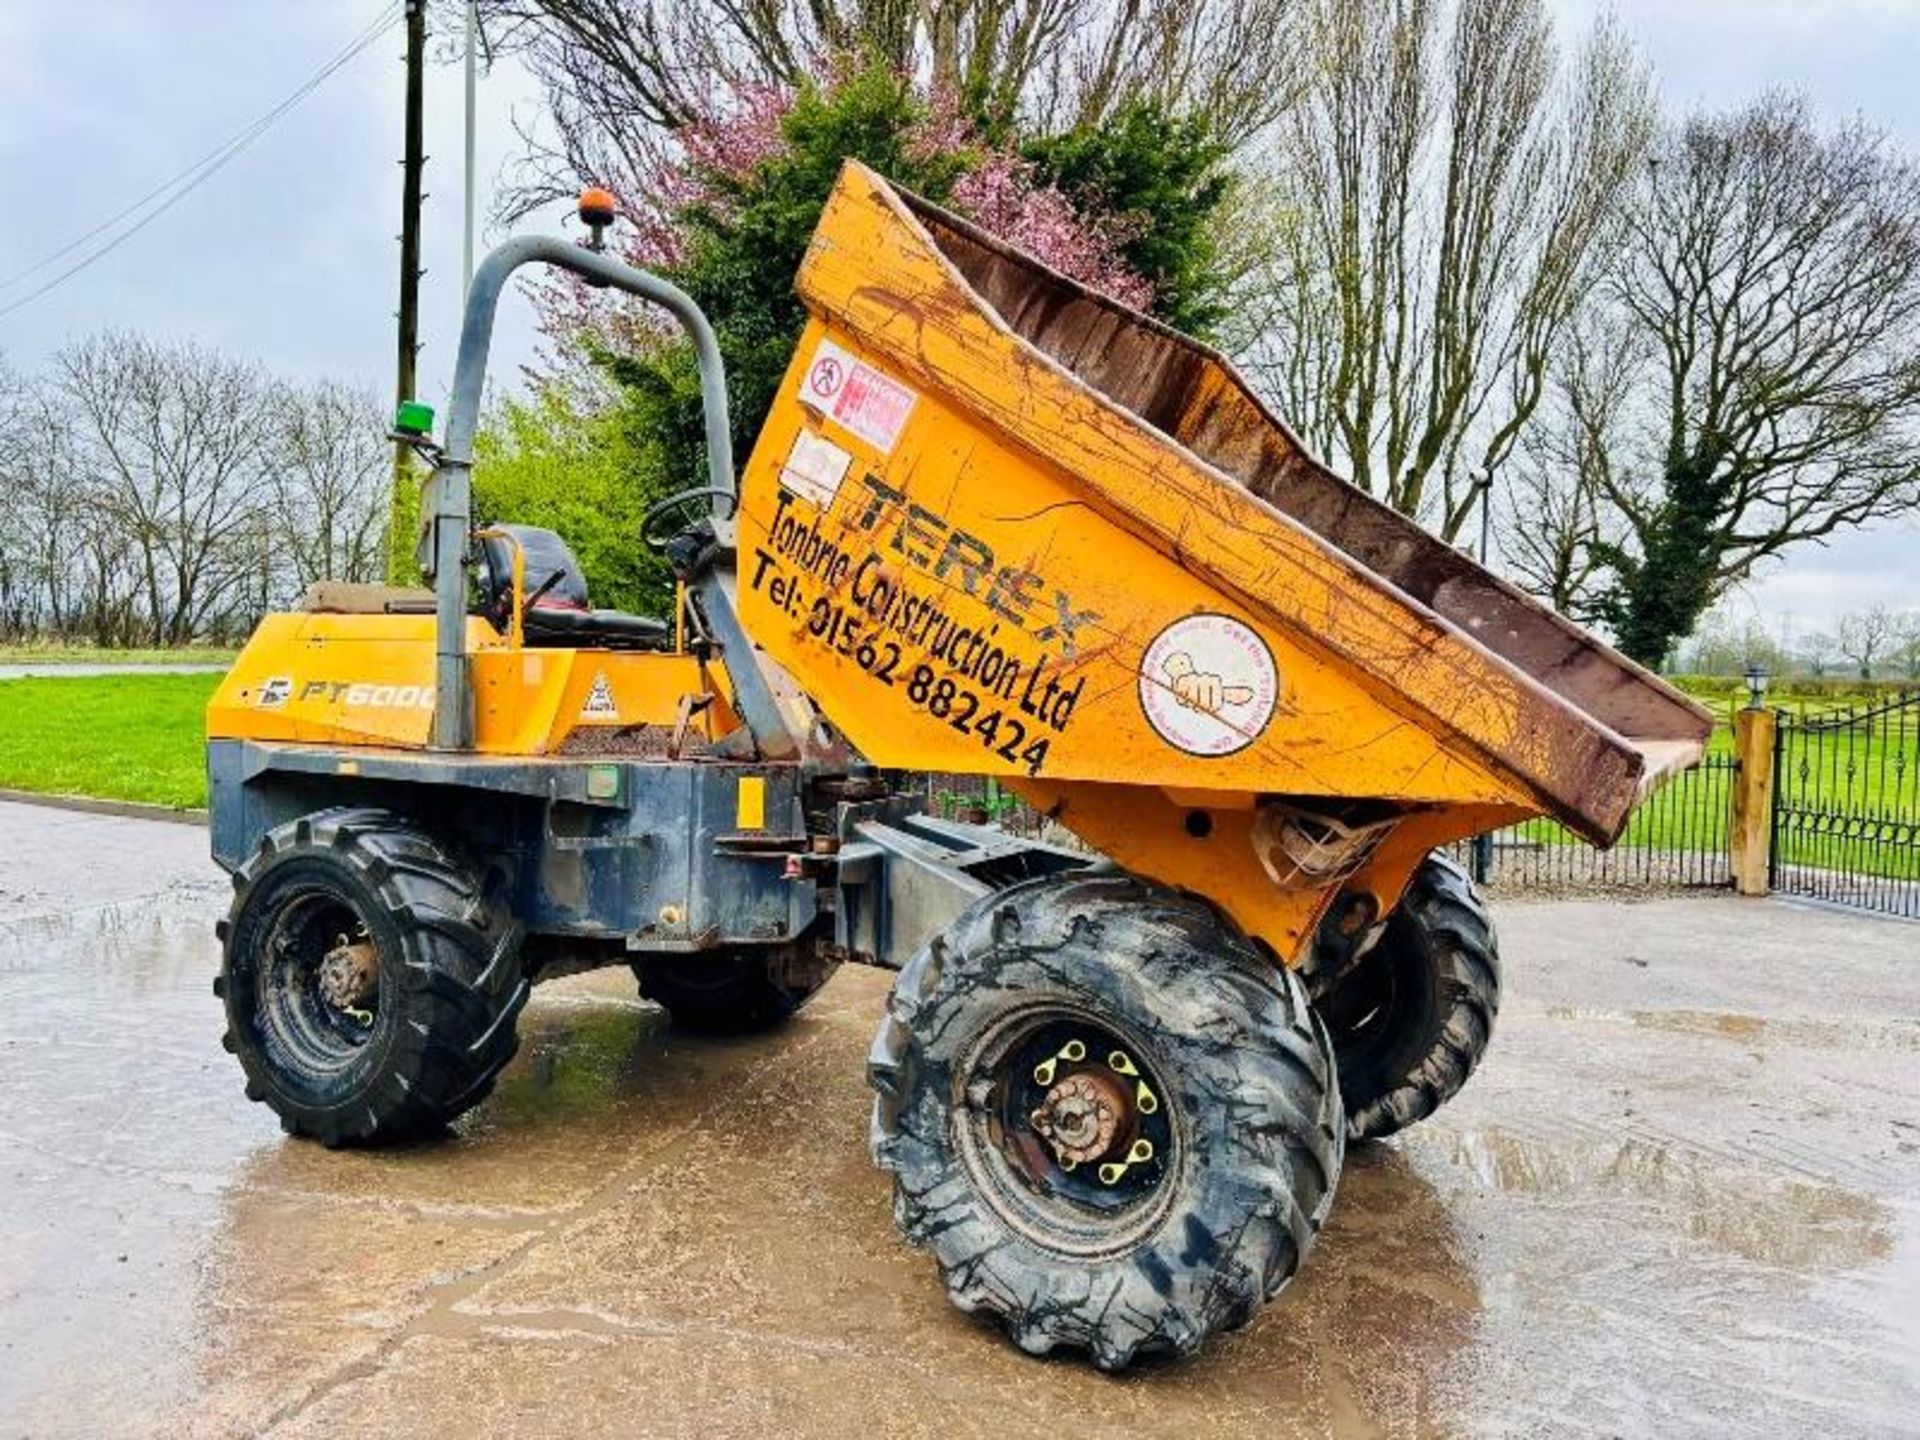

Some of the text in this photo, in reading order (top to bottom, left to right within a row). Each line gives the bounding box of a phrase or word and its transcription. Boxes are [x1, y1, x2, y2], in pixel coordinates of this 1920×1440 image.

[852, 552, 1021, 700] Construction
[1020, 654, 1085, 732] Ltd
[855, 472, 1103, 661] TEREX
[299, 680, 436, 709] PT6000
[751, 548, 803, 618] Tel:
[808, 596, 902, 686] 01562
[907, 665, 1051, 778] 882424
